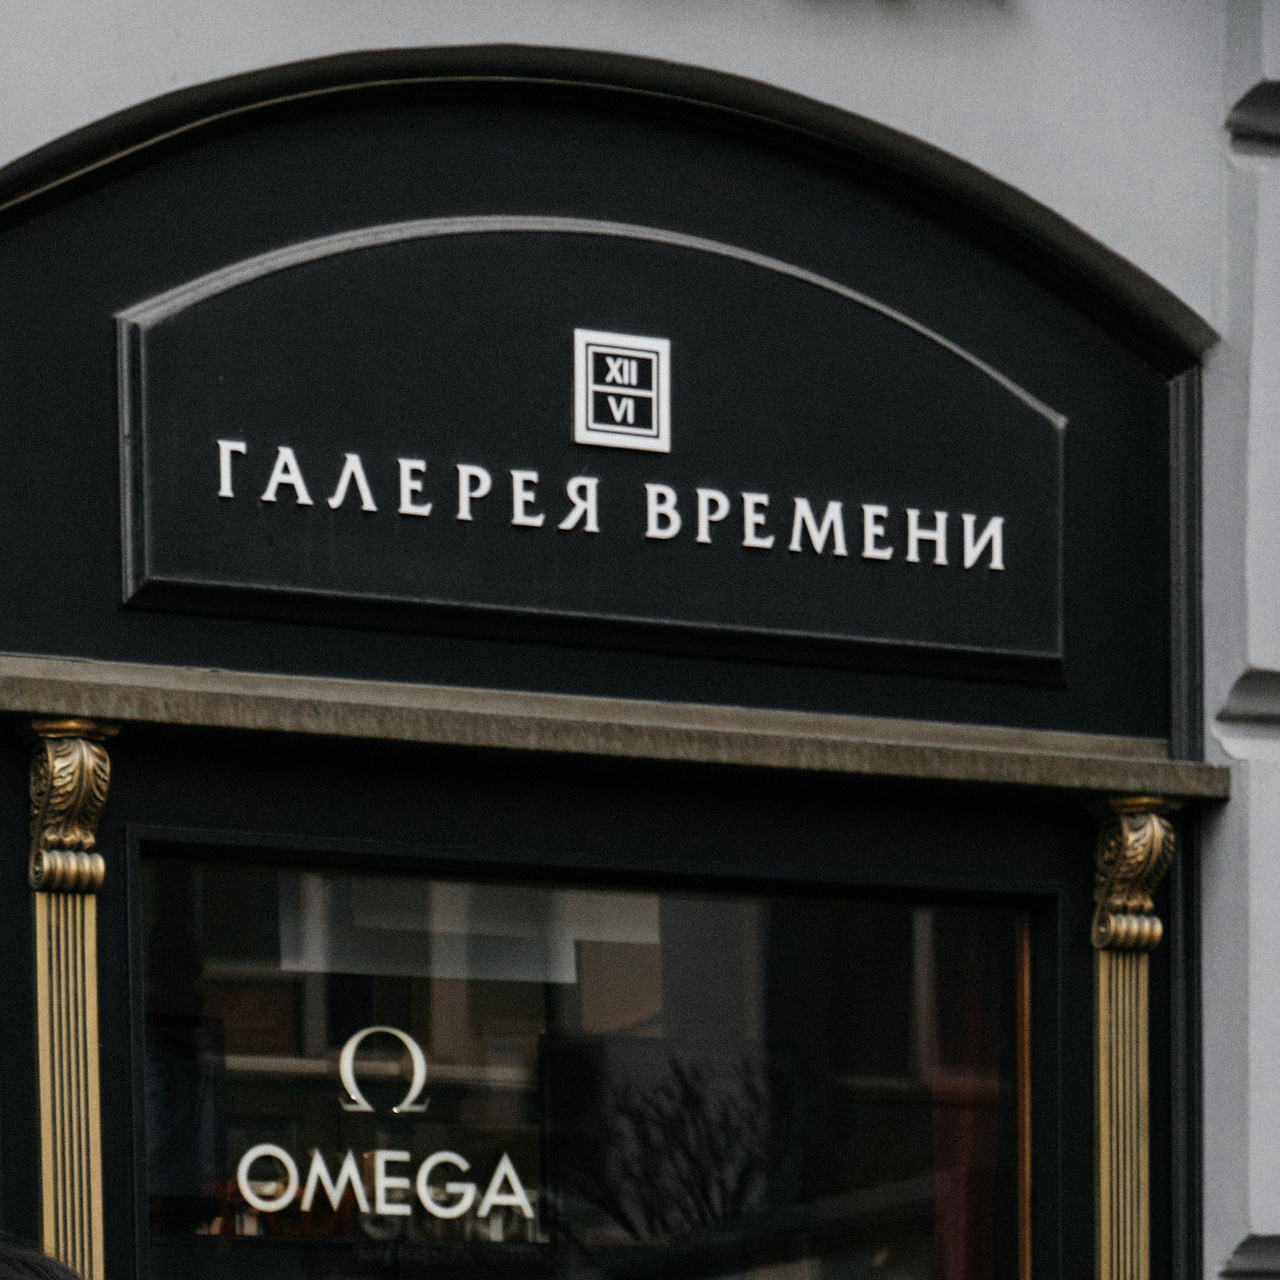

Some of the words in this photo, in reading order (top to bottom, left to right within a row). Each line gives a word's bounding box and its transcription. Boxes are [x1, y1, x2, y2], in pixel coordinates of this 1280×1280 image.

[604, 355, 639, 387] XII
[606, 395, 635, 425] VI
[216, 439, 600, 534] ГАЛЕРЕЯ
[644, 482, 1006, 571] ВРЕМЕНИ
[237, 1143, 536, 1220] OMEGA
